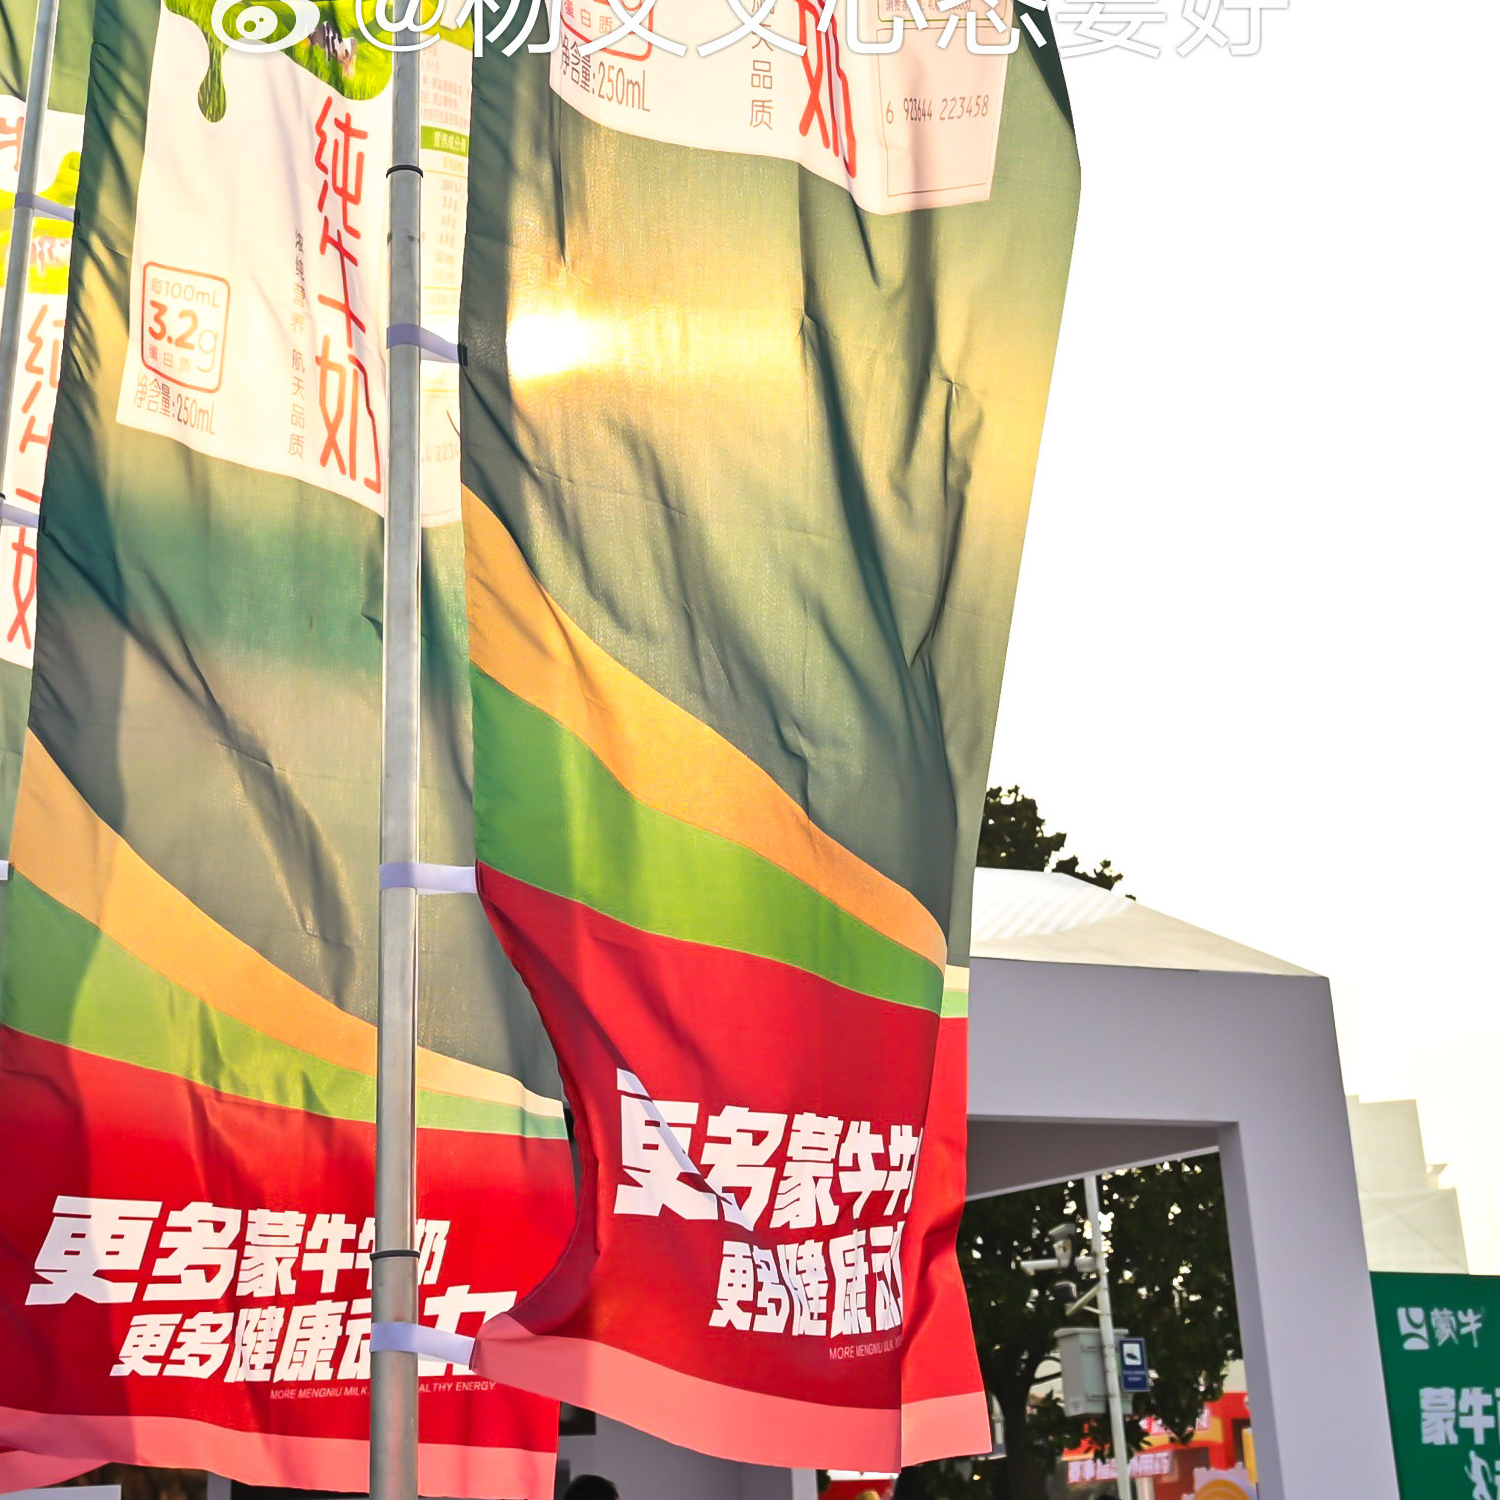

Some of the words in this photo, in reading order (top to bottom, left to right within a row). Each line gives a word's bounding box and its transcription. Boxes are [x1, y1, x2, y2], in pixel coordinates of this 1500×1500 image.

[150, 276, 221, 309] 每100mL
[314, 95, 382, 495] 纯牛奶
[148, 299, 219, 373] 3.2g
[455, 1381, 497, 1392] ENERGY
